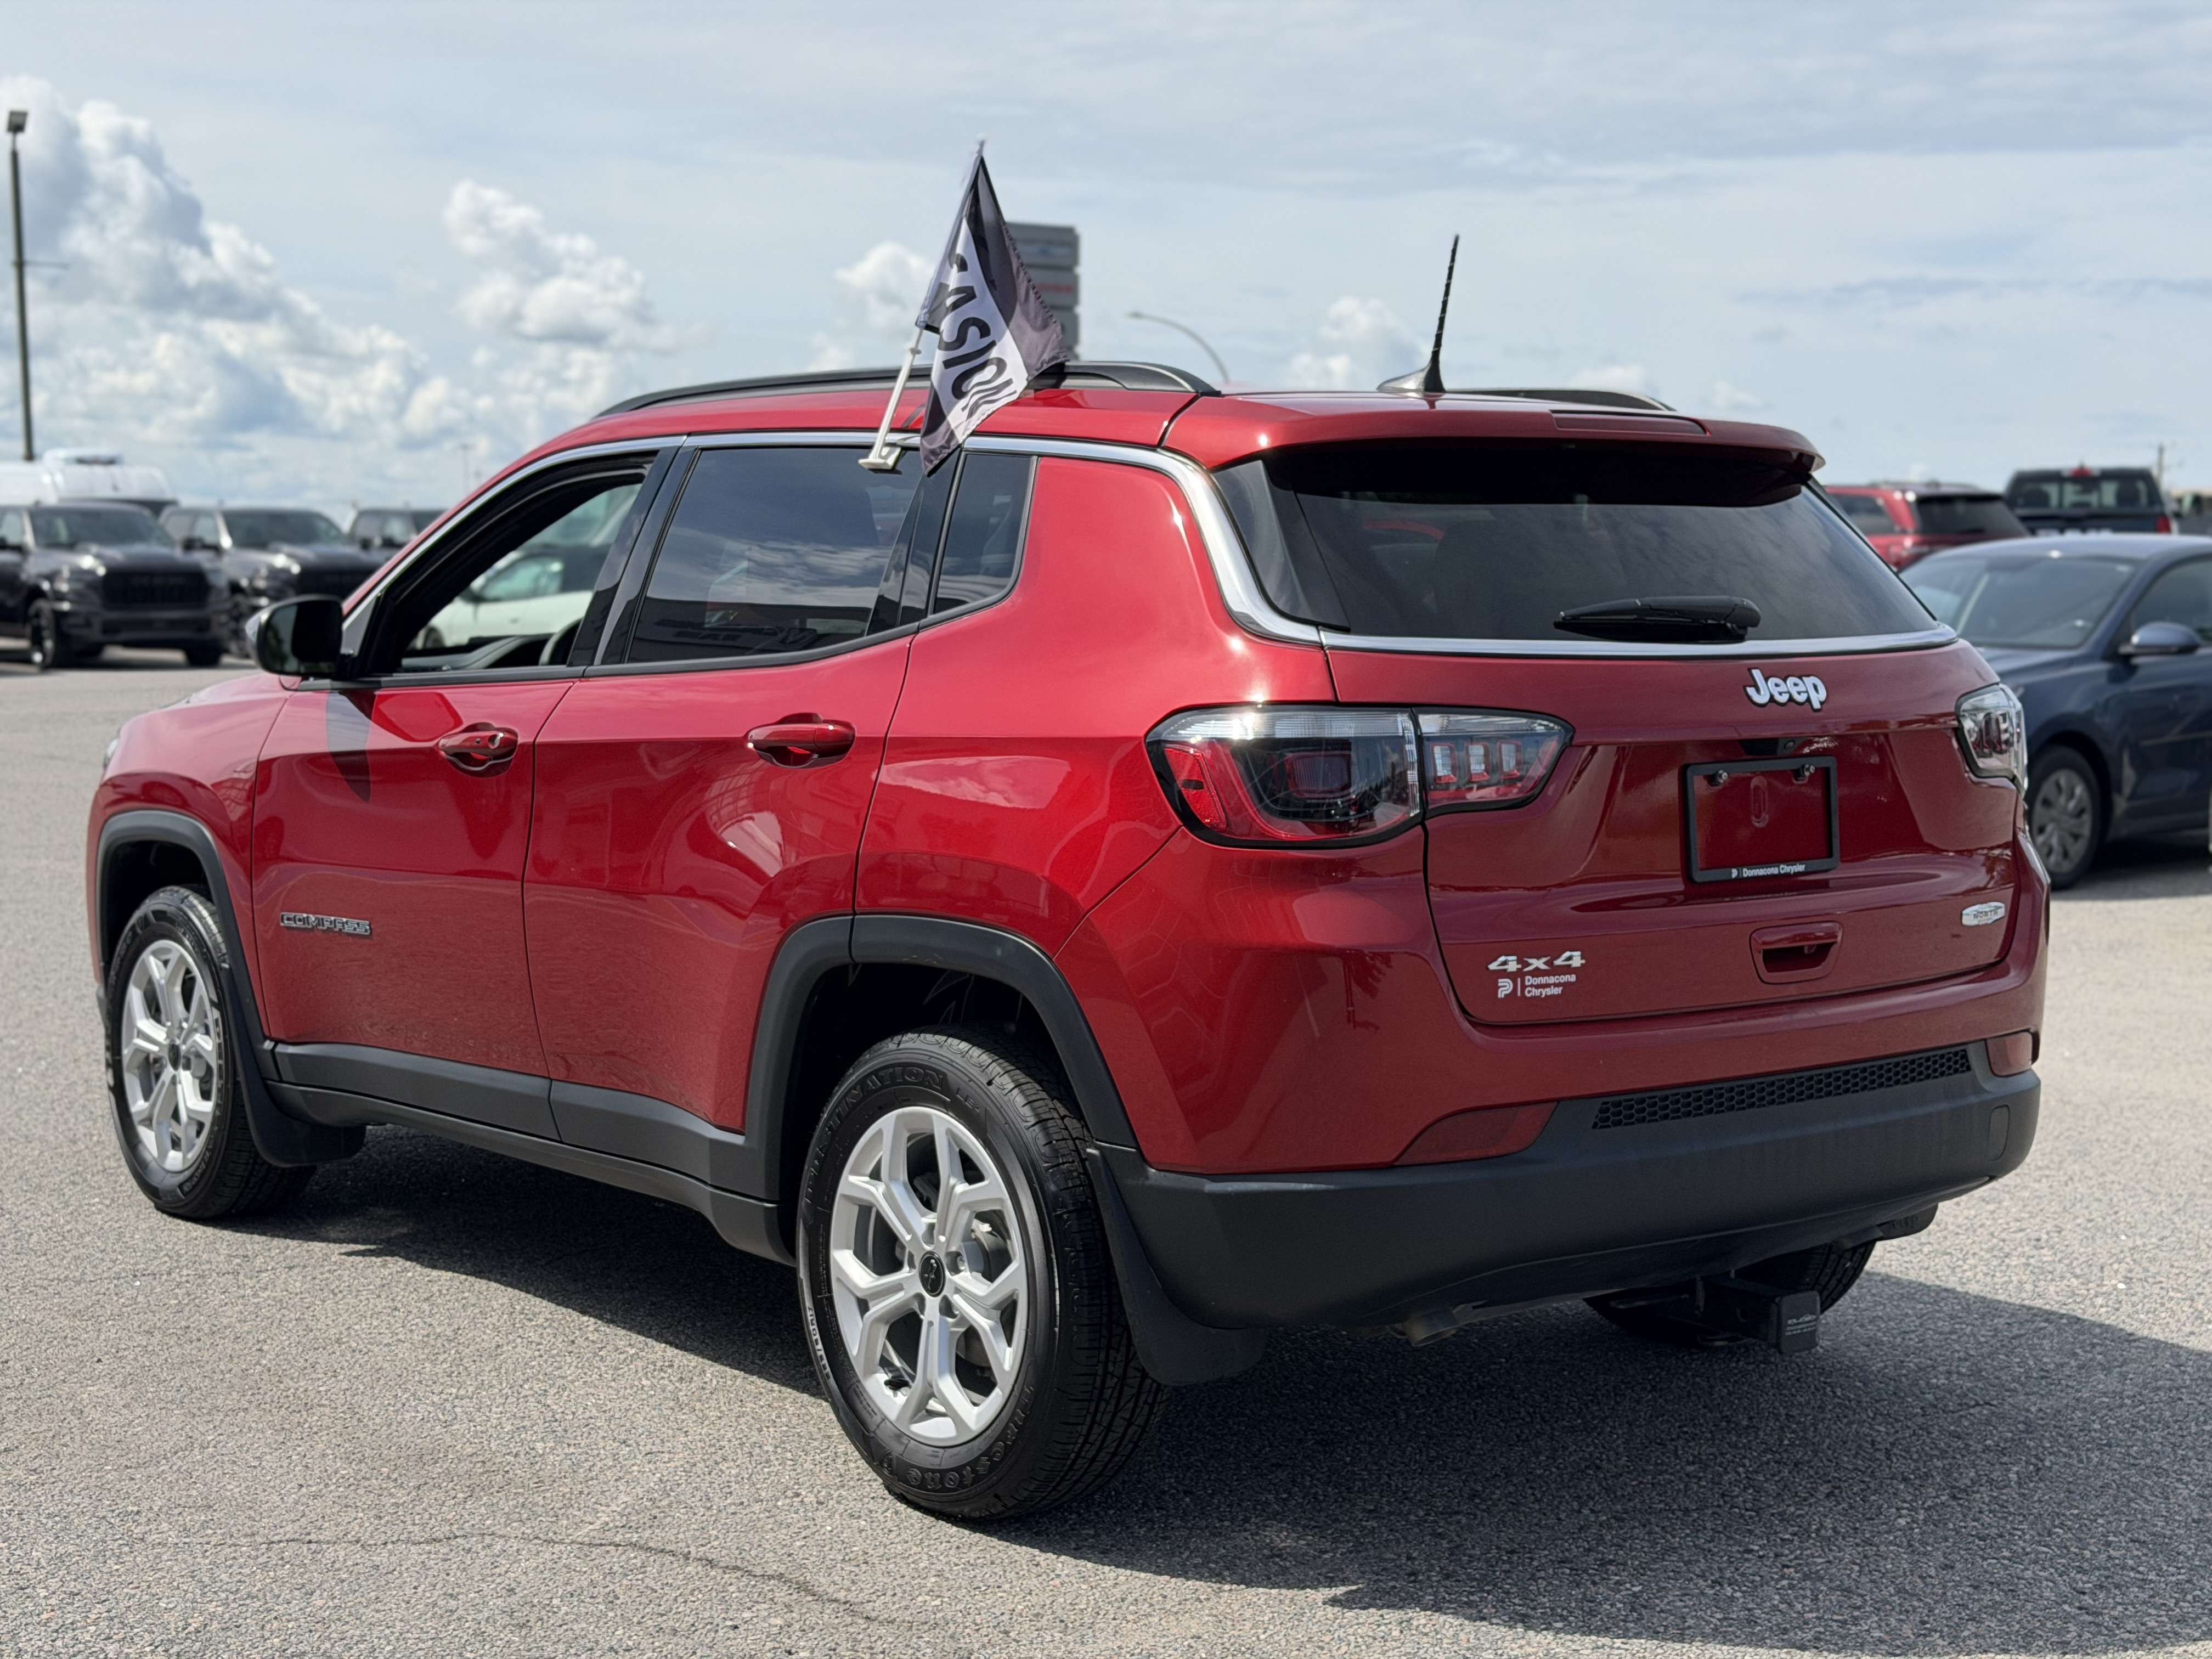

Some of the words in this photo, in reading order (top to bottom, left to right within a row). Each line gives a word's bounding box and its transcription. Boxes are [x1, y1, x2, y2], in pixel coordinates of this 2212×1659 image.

[1745, 668, 1828, 710] Jeep
[1742, 865, 1779, 877] Donnacona
[1779, 863, 1805, 874] Chrysler
[280, 912, 372, 935] COMPASS
[1525, 974, 1576, 985] Donnacona
[1525, 986, 1564, 997] Chrysler
